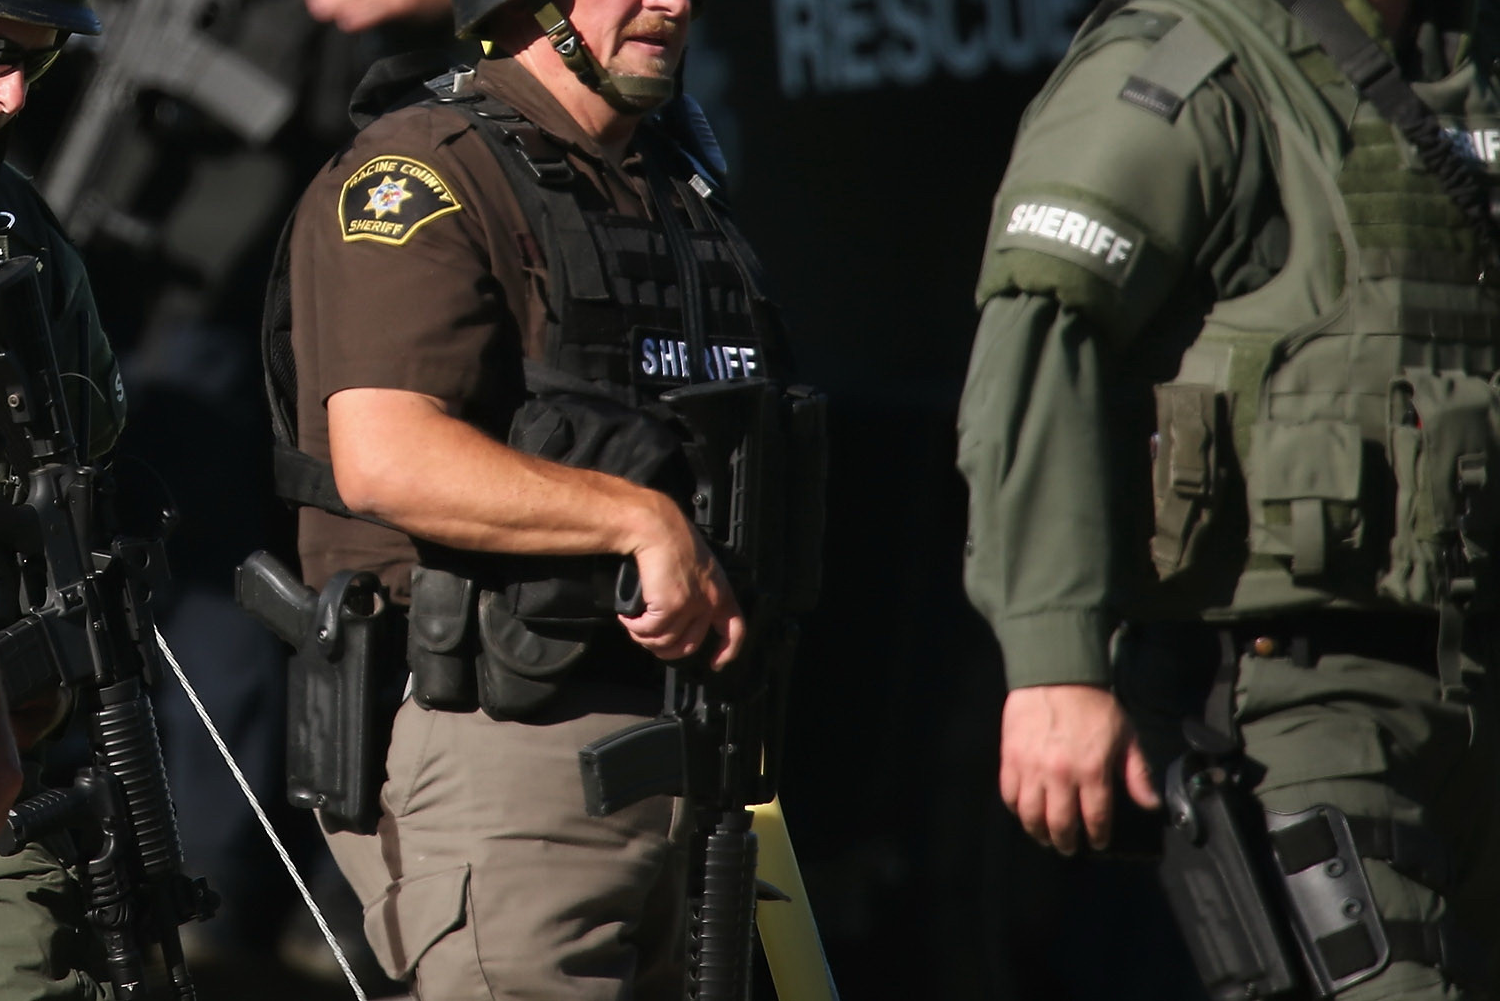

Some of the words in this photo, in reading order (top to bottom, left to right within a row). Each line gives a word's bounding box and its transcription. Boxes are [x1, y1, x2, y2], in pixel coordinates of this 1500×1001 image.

[400, 163, 452, 203] COUNTY
[348, 219, 403, 235] SHERIFF
[1006, 203, 1132, 264] SHERIFF
